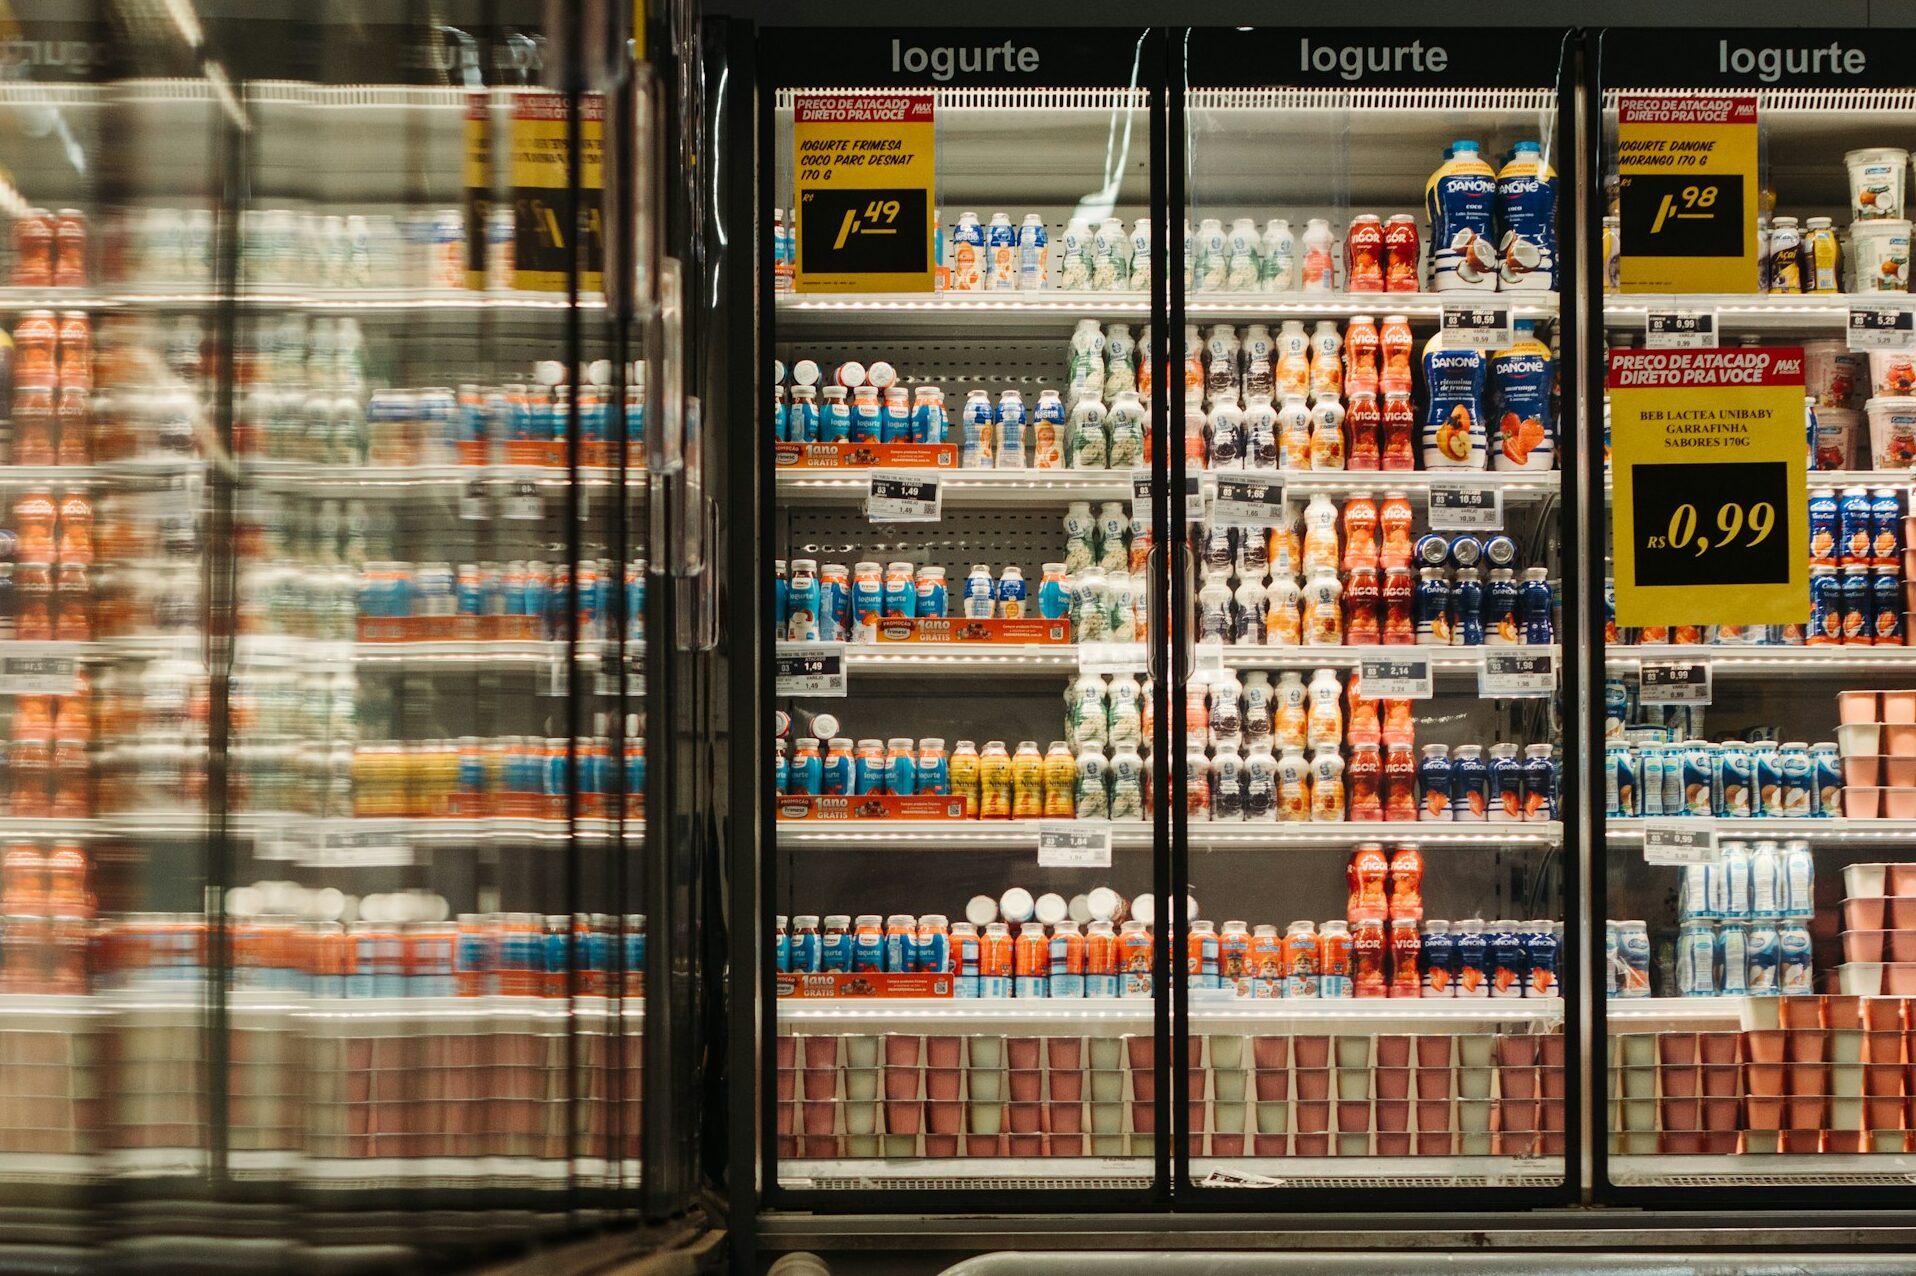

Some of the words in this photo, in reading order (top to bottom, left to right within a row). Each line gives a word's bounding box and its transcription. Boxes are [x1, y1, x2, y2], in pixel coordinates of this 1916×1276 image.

[892, 39, 1040, 81] Iogurte
[1301, 39, 1448, 81] Iogurte
[1719, 39, 1866, 81] Iogurte
[797, 99, 837, 111] PREÇO
[837, 99, 854, 109] DE
[854, 98, 910, 110] ATACADO
[1621, 100, 1661, 112] PREÇO
[1661, 100, 1678, 110] DE
[1677, 100, 1733, 111] ATACADO
[802, 110, 845, 120] DIRETO
[847, 110, 872, 120] PRA
[1626, 111, 1669, 121] DIRETO
[1671, 111, 1696, 121] PRA
[800, 140, 850, 151] IOGURTE
[852, 140, 902, 150] FRIMESA
[1619, 141, 1667, 151] IOGURTE
[1670, 141, 1716, 151] DANONE
[801, 155, 831, 165] COCO
[834, 155, 865, 165] PARC
[868, 154, 914, 165] DESNAT
[1619, 156, 1674, 166] MORANGO
[1677, 156, 1696, 166] 170
[1700, 156, 1708, 166] G
[801, 170, 820, 180] 170
[824, 170, 832, 180] G
[1612, 355, 1667, 372] PREÇO
[1669, 354, 1691, 369] DE
[1691, 353, 1770, 369] ATACADO
[1772, 359, 1801, 375] MAX
[1620, 369, 1681, 385] DIRETO
[1683, 369, 1719, 384] PRA
[1640, 411, 1664, 421] BEB
[1667, 410, 1715, 420] LACTEA
[1719, 409, 1774, 420] UNIBABY
[1666, 424, 1748, 434] GARRAFINHA
[1664, 438, 1720, 448] SABORES
[1723, 437, 1751, 447] 170G
[900, 486, 919, 496] 1,49
[1459, 495, 1482, 504] 10,59
[1668, 502, 1776, 558] 0,99
[804, 662, 823, 671] 1,49
[1395, 939, 1421, 949] VIGO
